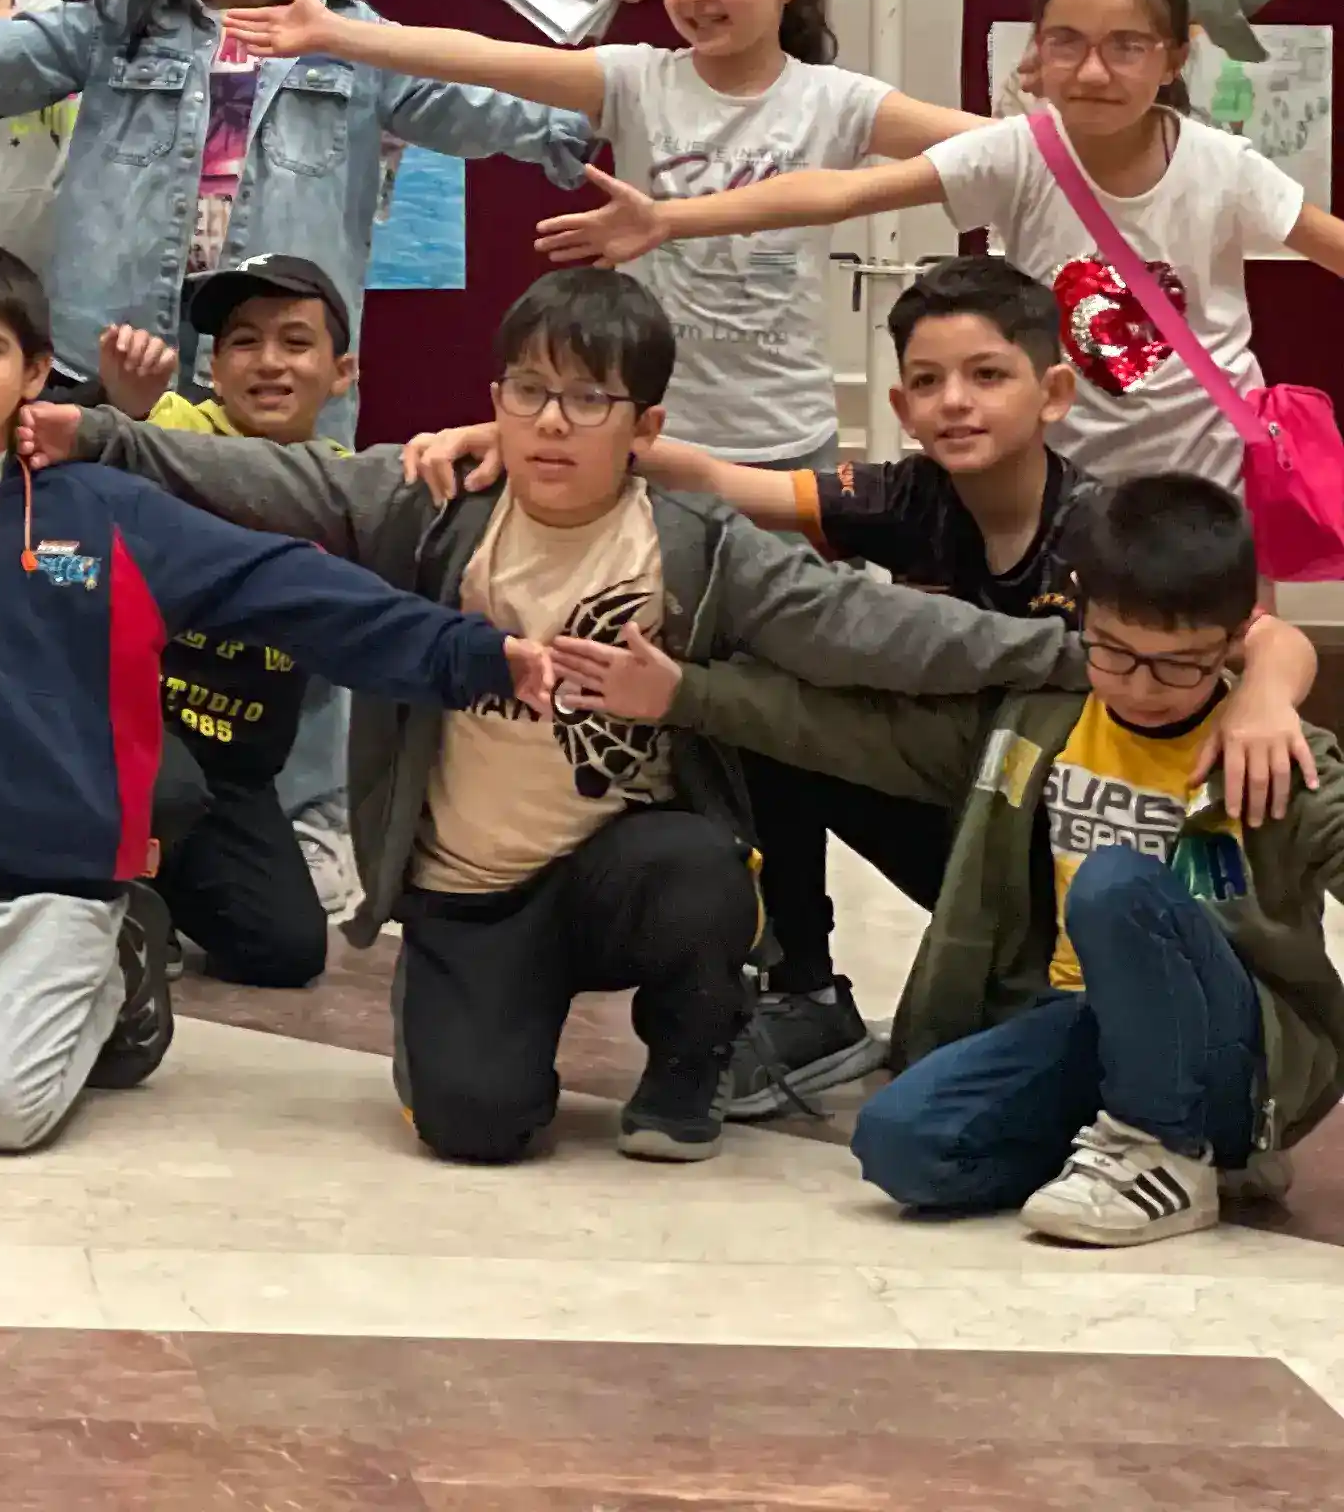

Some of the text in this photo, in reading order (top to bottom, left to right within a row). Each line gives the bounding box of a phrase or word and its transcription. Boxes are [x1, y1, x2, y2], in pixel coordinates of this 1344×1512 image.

[162, 675, 264, 723] TUDIO
[180, 708, 233, 743] 985
[1043, 765, 1187, 828] SUPE
[1070, 817, 1176, 864] SPOR
